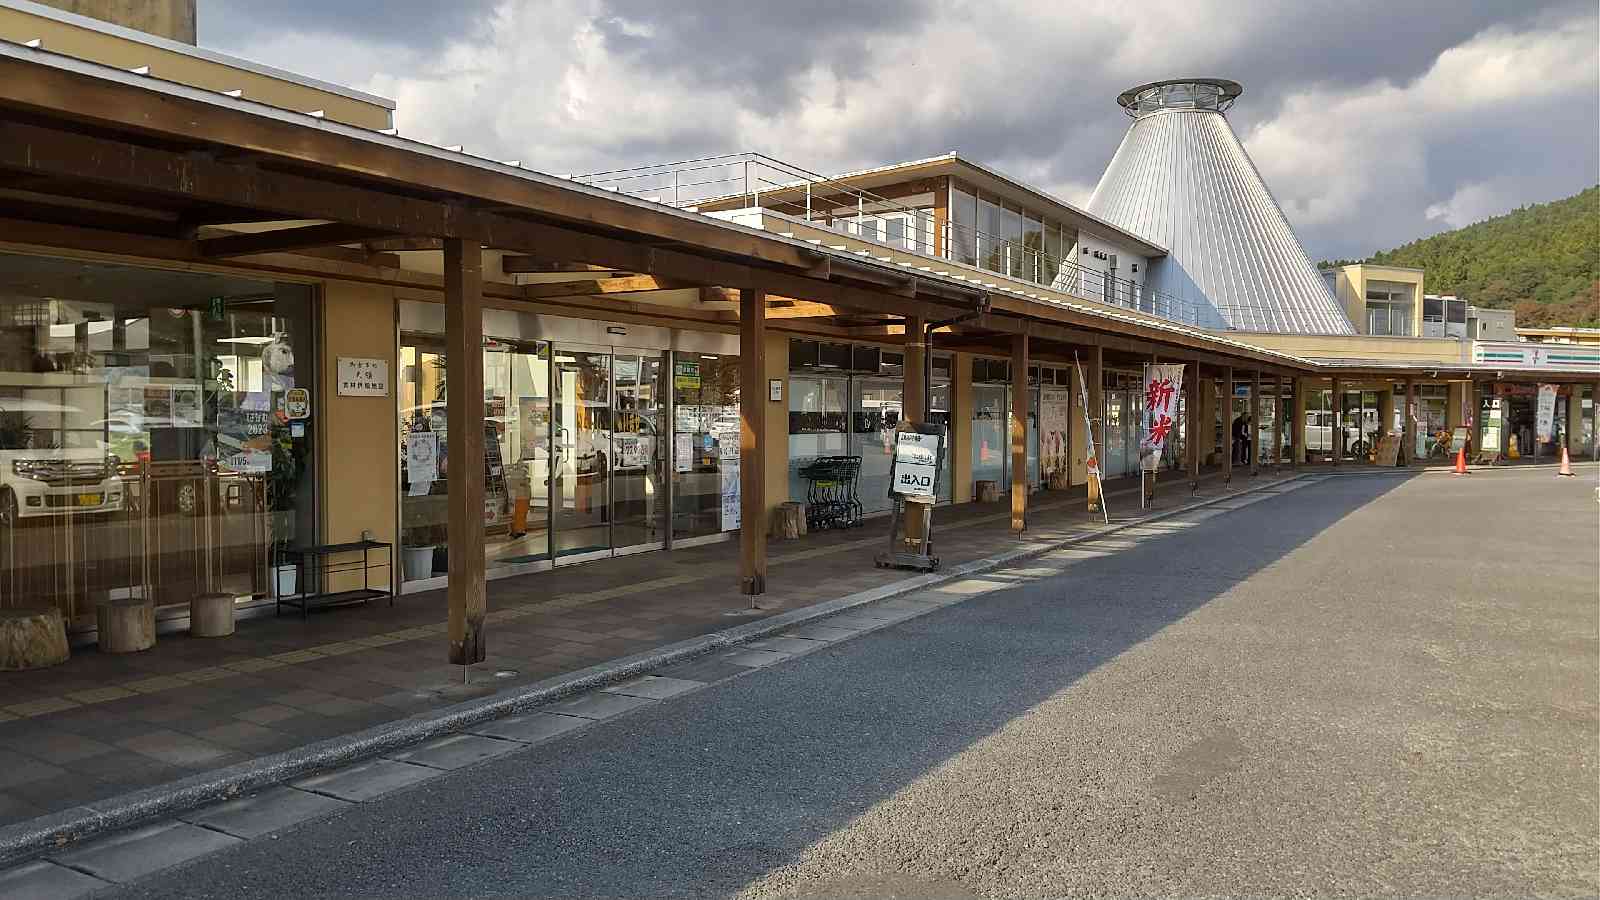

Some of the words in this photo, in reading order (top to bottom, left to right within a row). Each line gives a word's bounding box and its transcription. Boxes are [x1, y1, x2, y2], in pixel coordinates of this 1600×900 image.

[1145, 379, 1175, 445] 新米
[900, 473, 931, 487] 出入口
